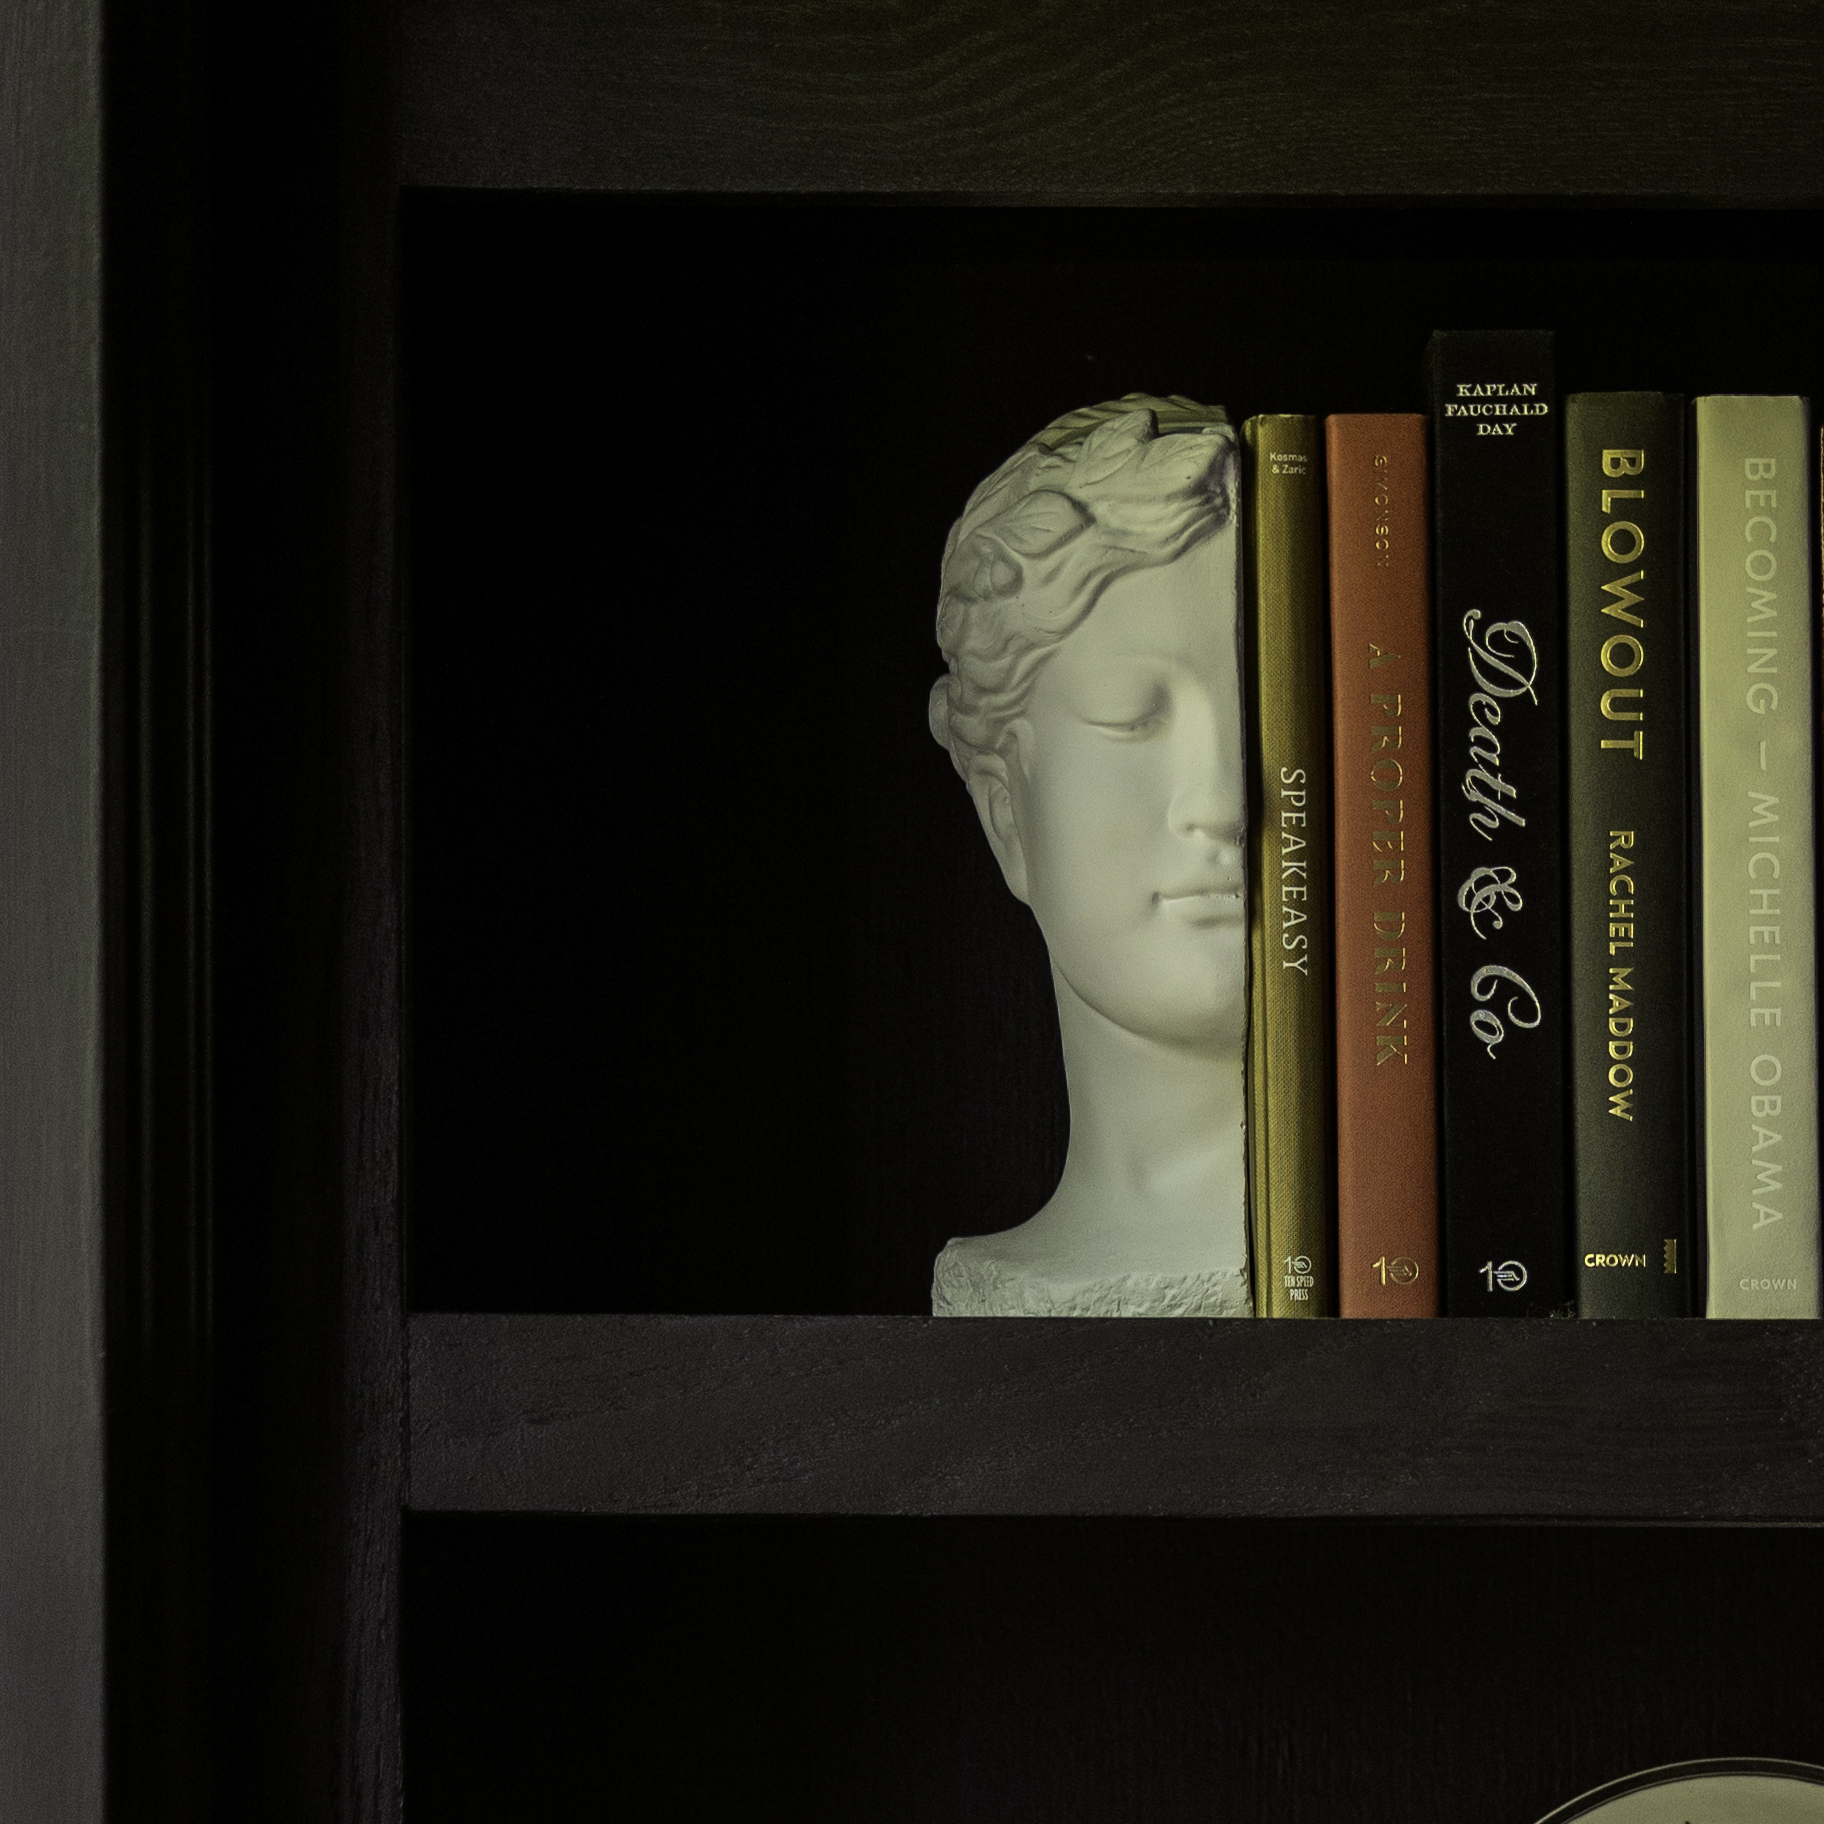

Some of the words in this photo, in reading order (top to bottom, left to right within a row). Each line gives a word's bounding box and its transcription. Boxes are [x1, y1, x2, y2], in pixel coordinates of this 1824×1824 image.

[1444, 403, 1549, 417] FAUCHALD
[1456, 383, 1538, 397] KAPLAN
[1476, 423, 1517, 436] DAY
[1269, 452, 1307, 463] Kosmas
[1272, 465, 1280, 475] &
[1282, 465, 1307, 475] Zaric
[1374, 456, 1389, 567] SIMONSON
[1599, 449, 1645, 760] BLOWOUT
[1744, 457, 1779, 715] BECOMING
[1367, 643, 1400, 670] A
[1461, 608, 1539, 842] Death
[1369, 692, 1404, 887] PROPER
[1280, 767, 1308, 975] SPEAKEASY
[1457, 865, 1524, 940] &
[1607, 830, 1635, 956] RACHEL
[1746, 791, 1782, 1028] MICHELLE
[1374, 911, 1408, 1065] DRINK
[1469, 964, 1542, 1060] Co
[1607, 967, 1635, 1122] MADDOW
[1748, 1055, 1784, 1232] OBAMA
[1284, 1276, 1296, 1288] TEN
[1296, 1276, 1315, 1288] SPEED
[1290, 1289, 1308, 1301] PRESS
[1584, 1253, 1647, 1268] CROWN
[1739, 1278, 1797, 1290] CROWN
